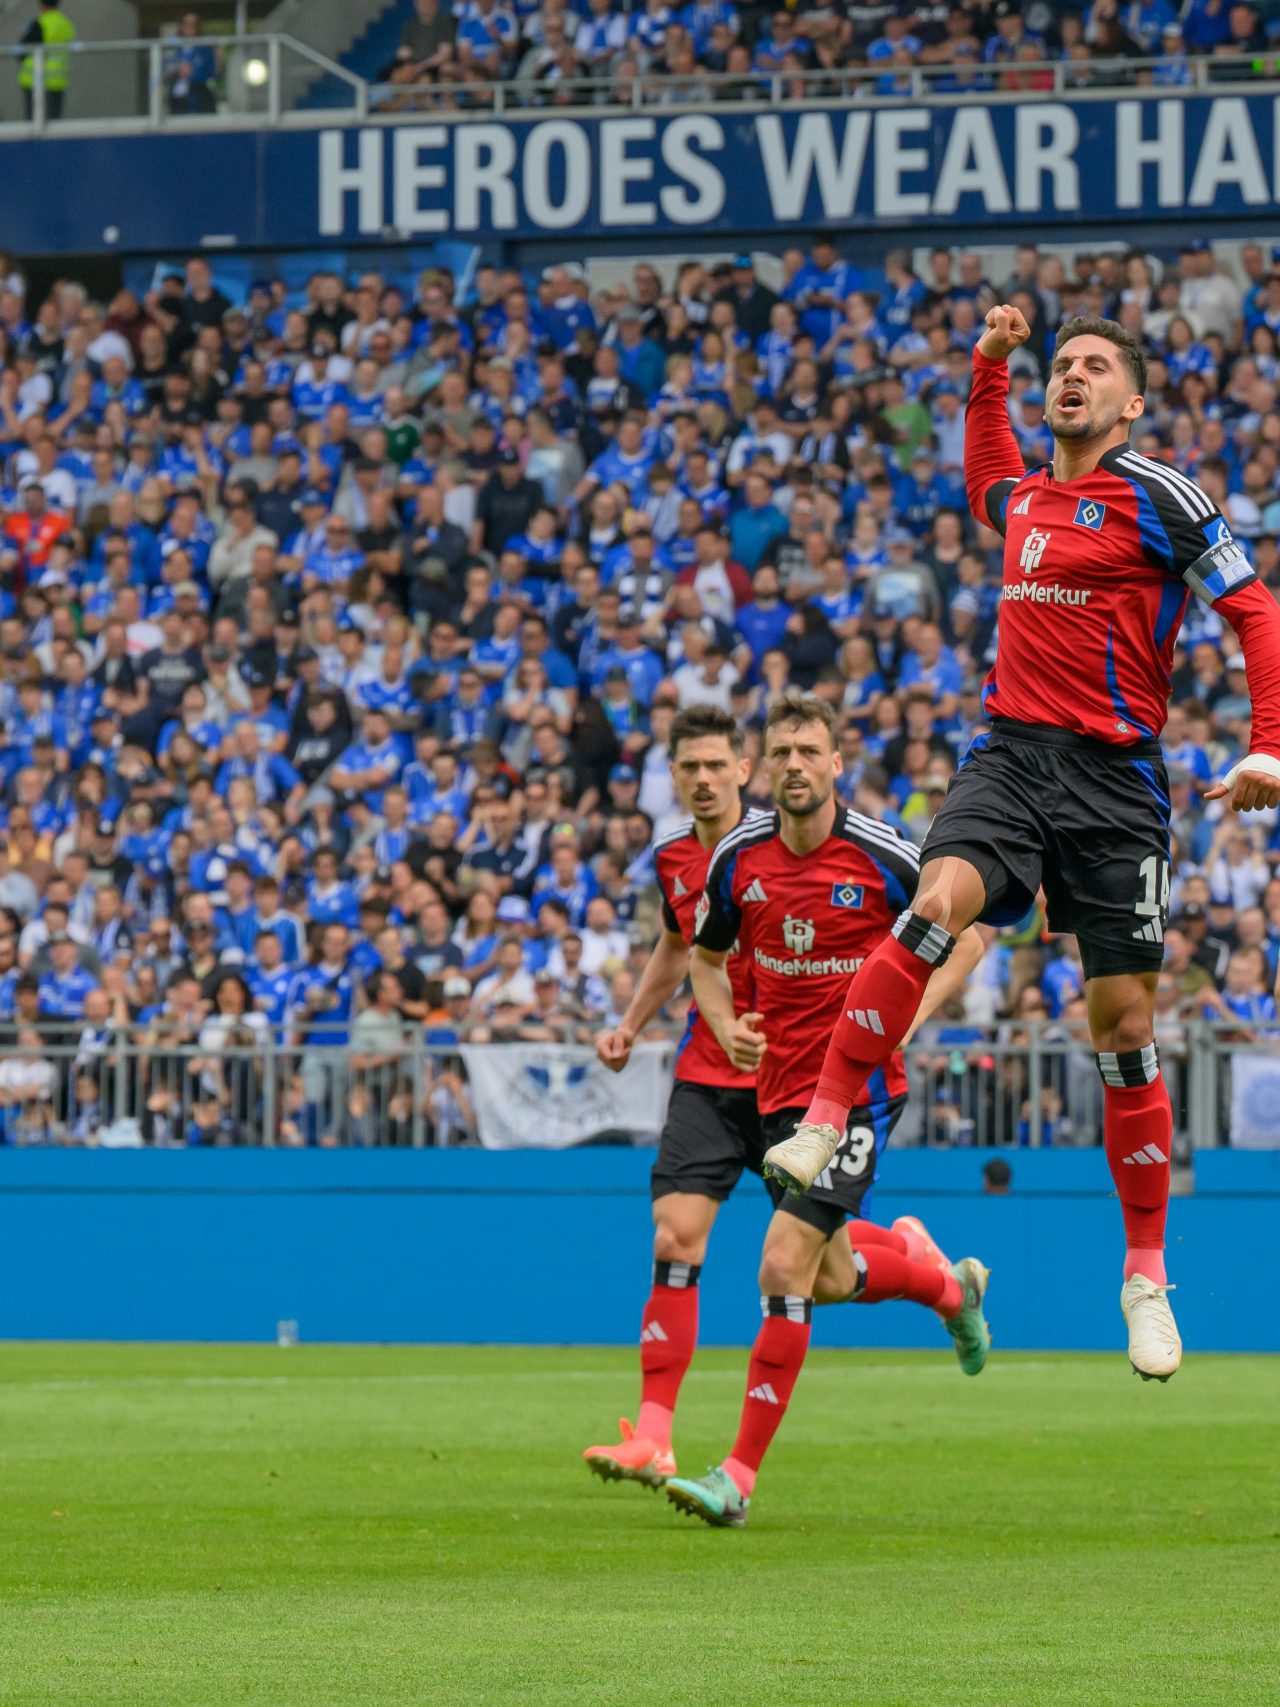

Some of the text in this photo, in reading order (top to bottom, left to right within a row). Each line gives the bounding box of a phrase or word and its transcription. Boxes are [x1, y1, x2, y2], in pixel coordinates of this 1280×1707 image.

[319, 114, 725, 236] HEROES
[755, 103, 1079, 221] WEAR
[754, 946, 865, 976] HanseMerkur
